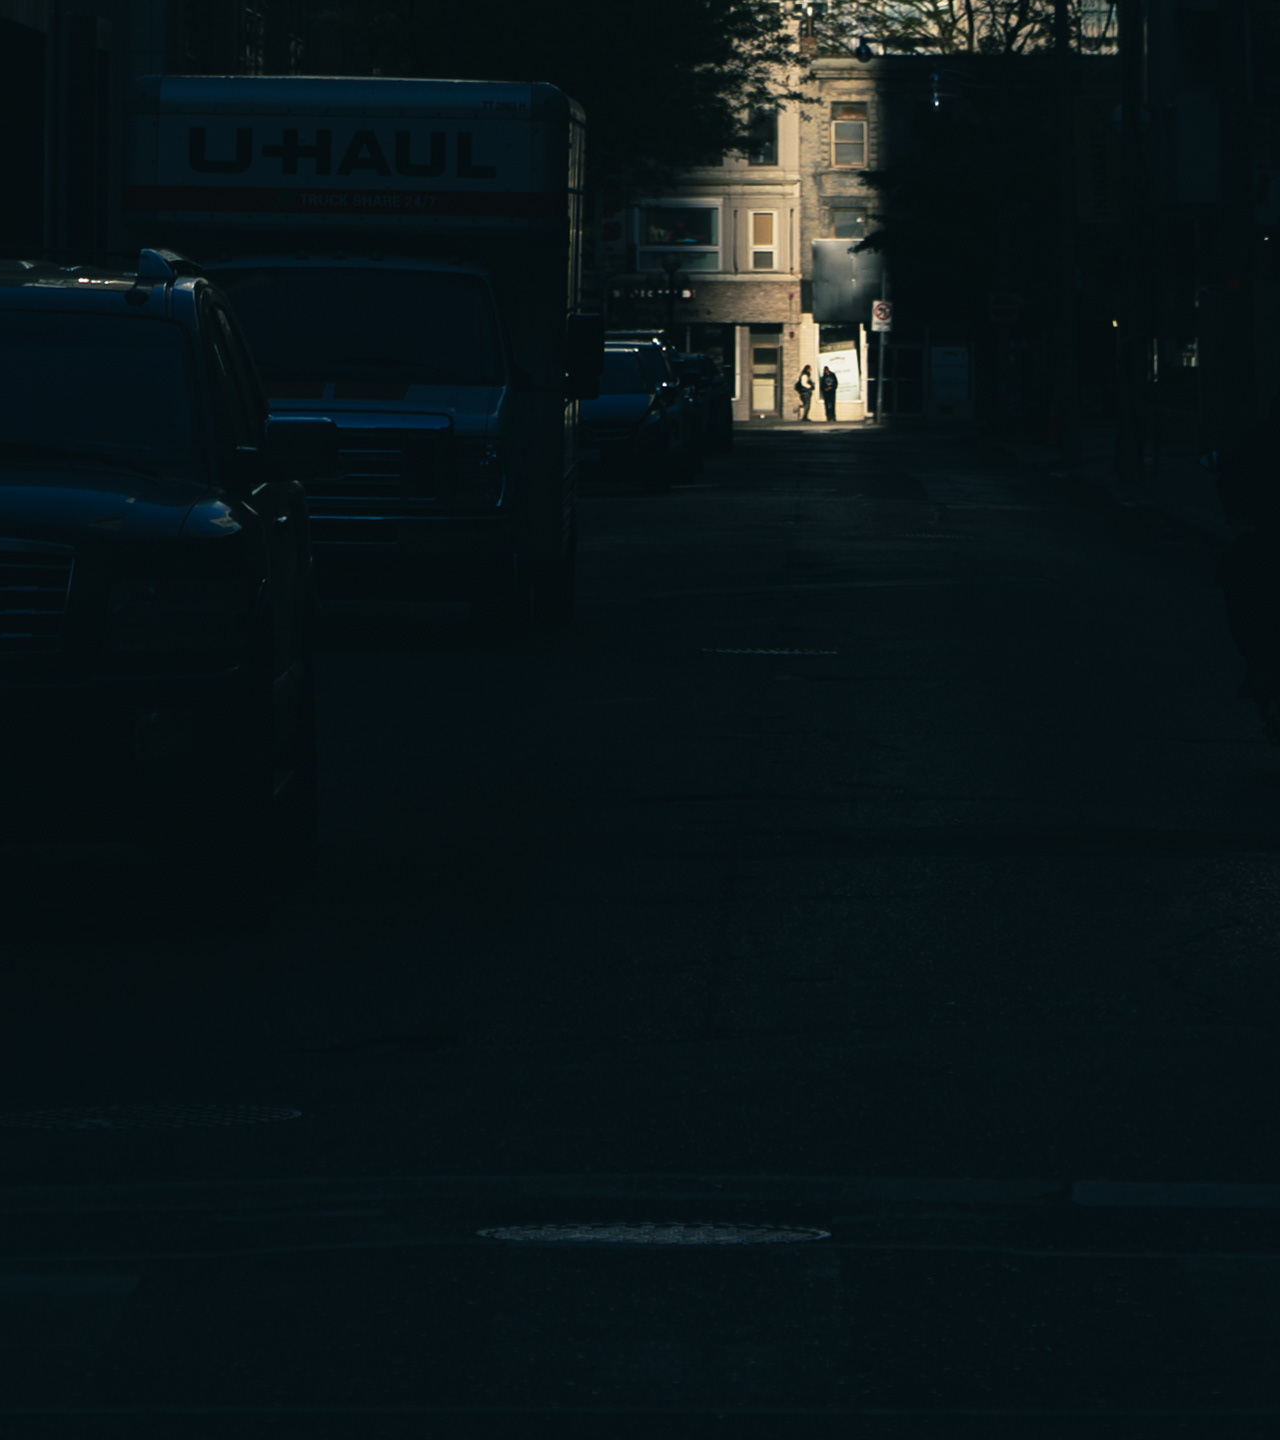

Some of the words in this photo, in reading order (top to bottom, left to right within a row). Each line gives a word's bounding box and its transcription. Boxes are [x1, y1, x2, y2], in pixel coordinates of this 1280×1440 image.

[188, 126, 498, 180] U-HAUL
[299, 192, 349, 207] TRUCK
[352, 193, 401, 208] SHARE
[403, 195, 437, 209] 24/7
